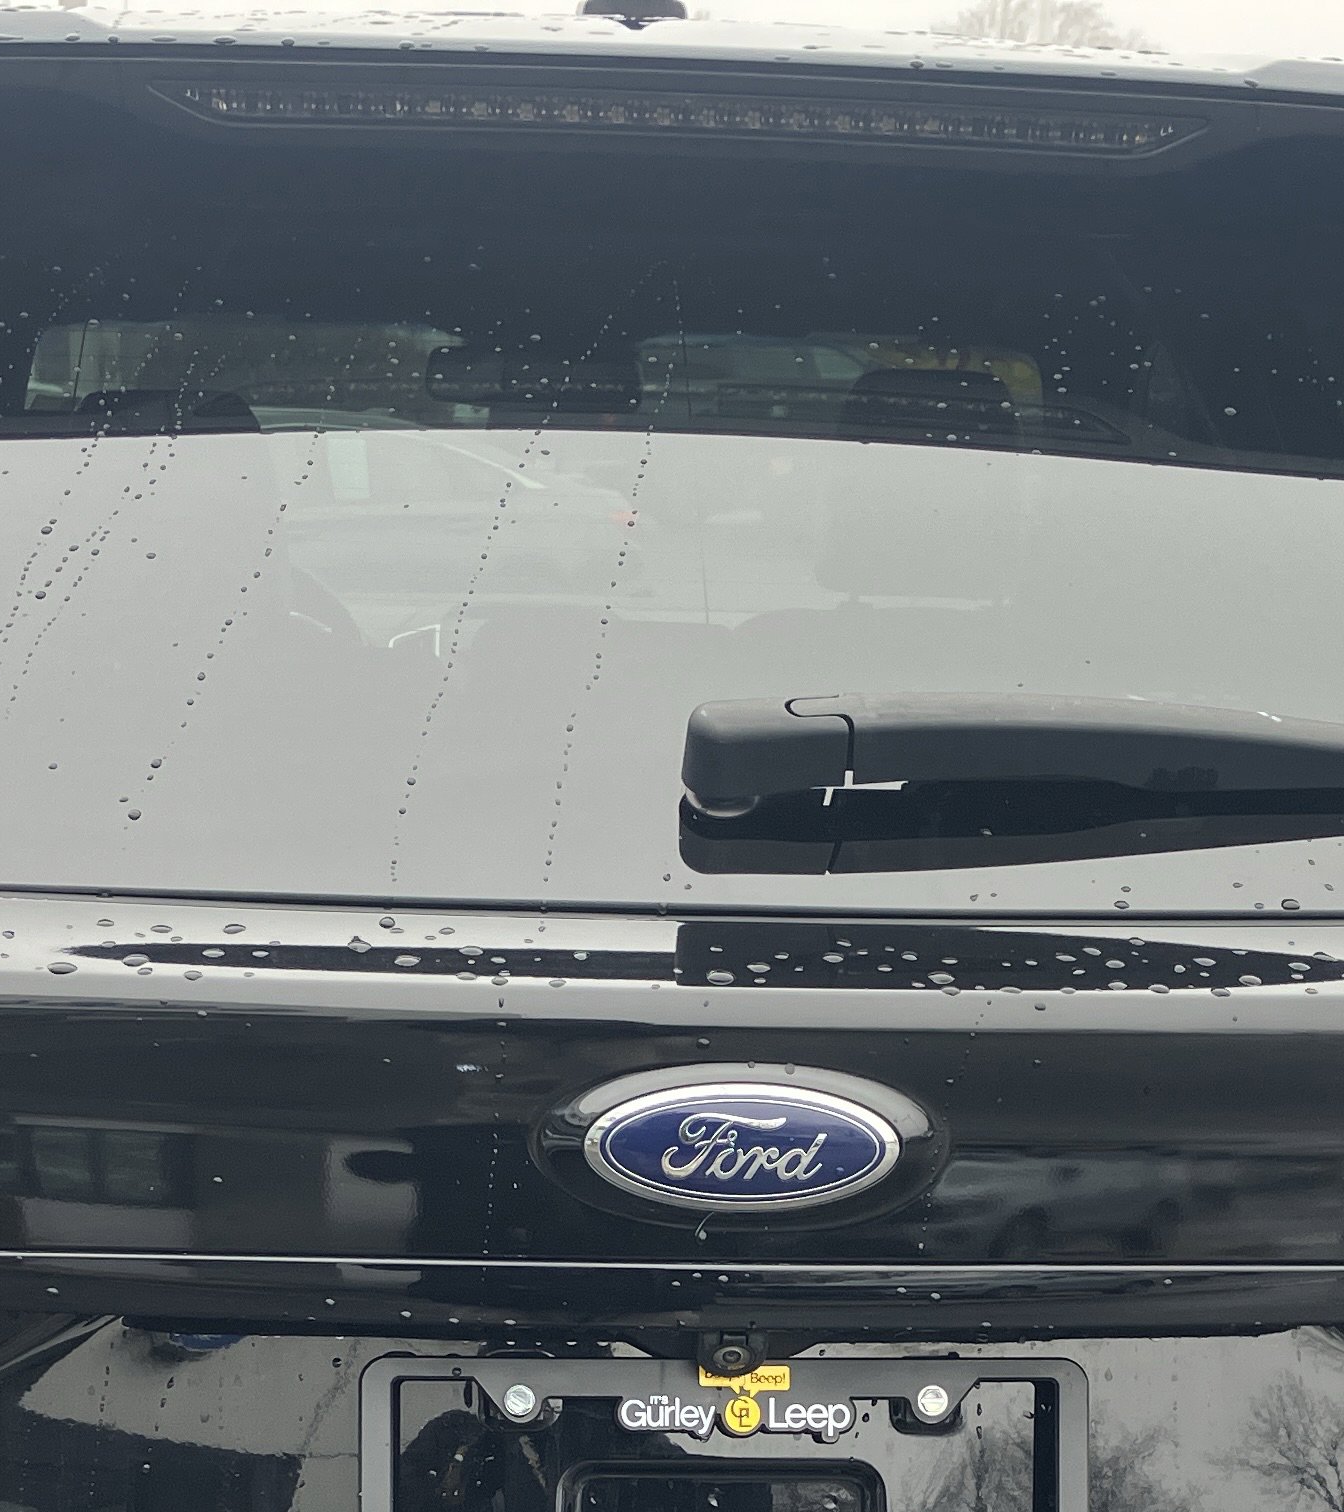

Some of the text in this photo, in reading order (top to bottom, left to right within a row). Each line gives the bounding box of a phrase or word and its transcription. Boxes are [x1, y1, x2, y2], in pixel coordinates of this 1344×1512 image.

[661, 1112, 828, 1180] Ford
[750, 1372, 786, 1386] Beep!
[621, 1397, 716, 1434] Gurley
[768, 1397, 851, 1436] Leep
